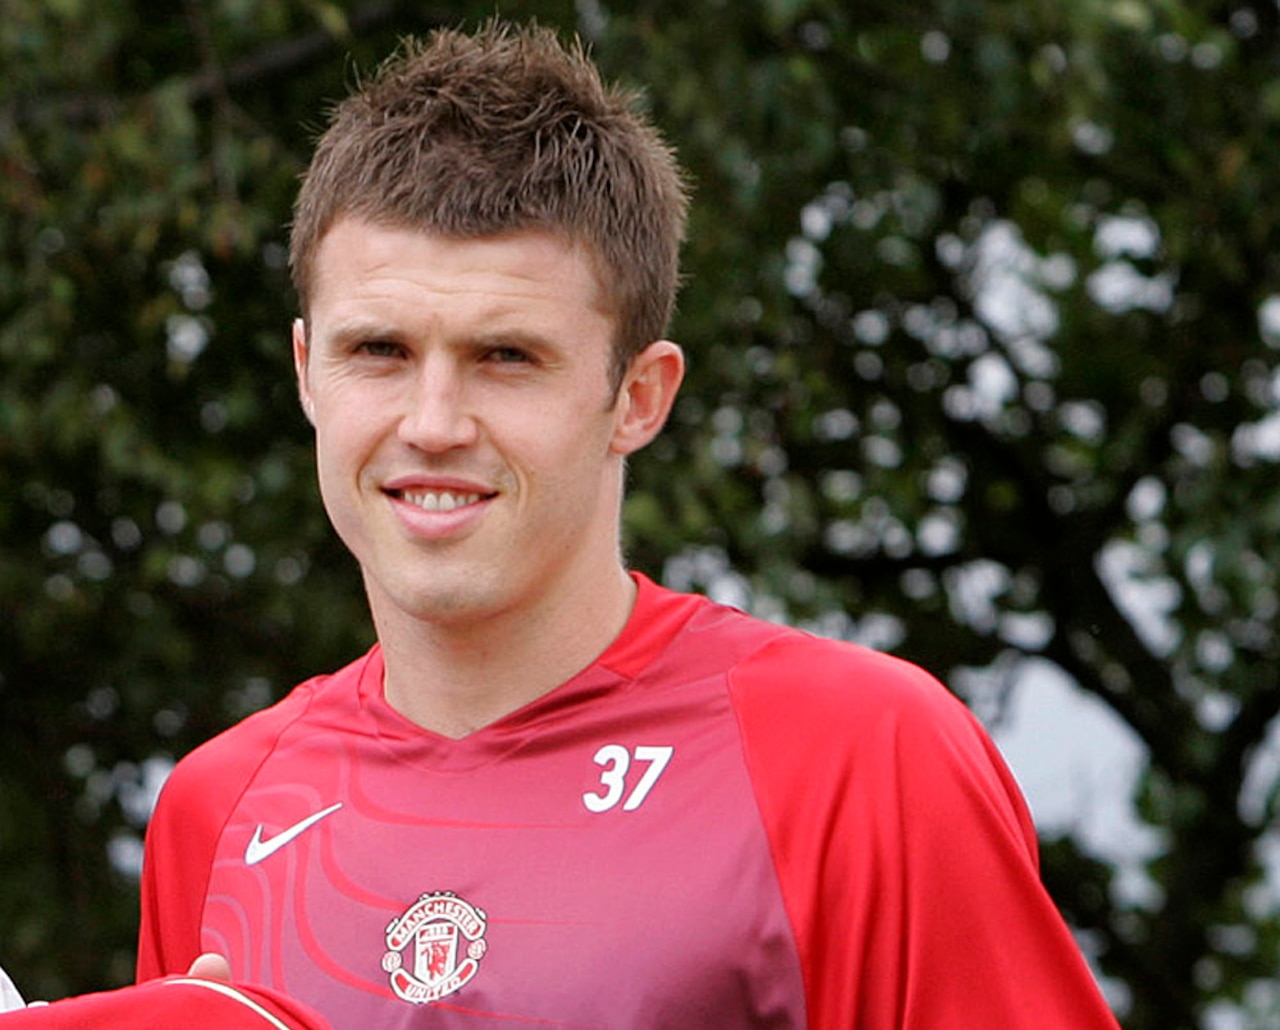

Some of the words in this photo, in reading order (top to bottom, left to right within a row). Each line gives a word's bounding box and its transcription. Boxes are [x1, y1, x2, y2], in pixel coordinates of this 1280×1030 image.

[582, 744, 675, 813] 37
[395, 901, 480, 941] MANCHESTER
[404, 976, 462, 999] UNITED
